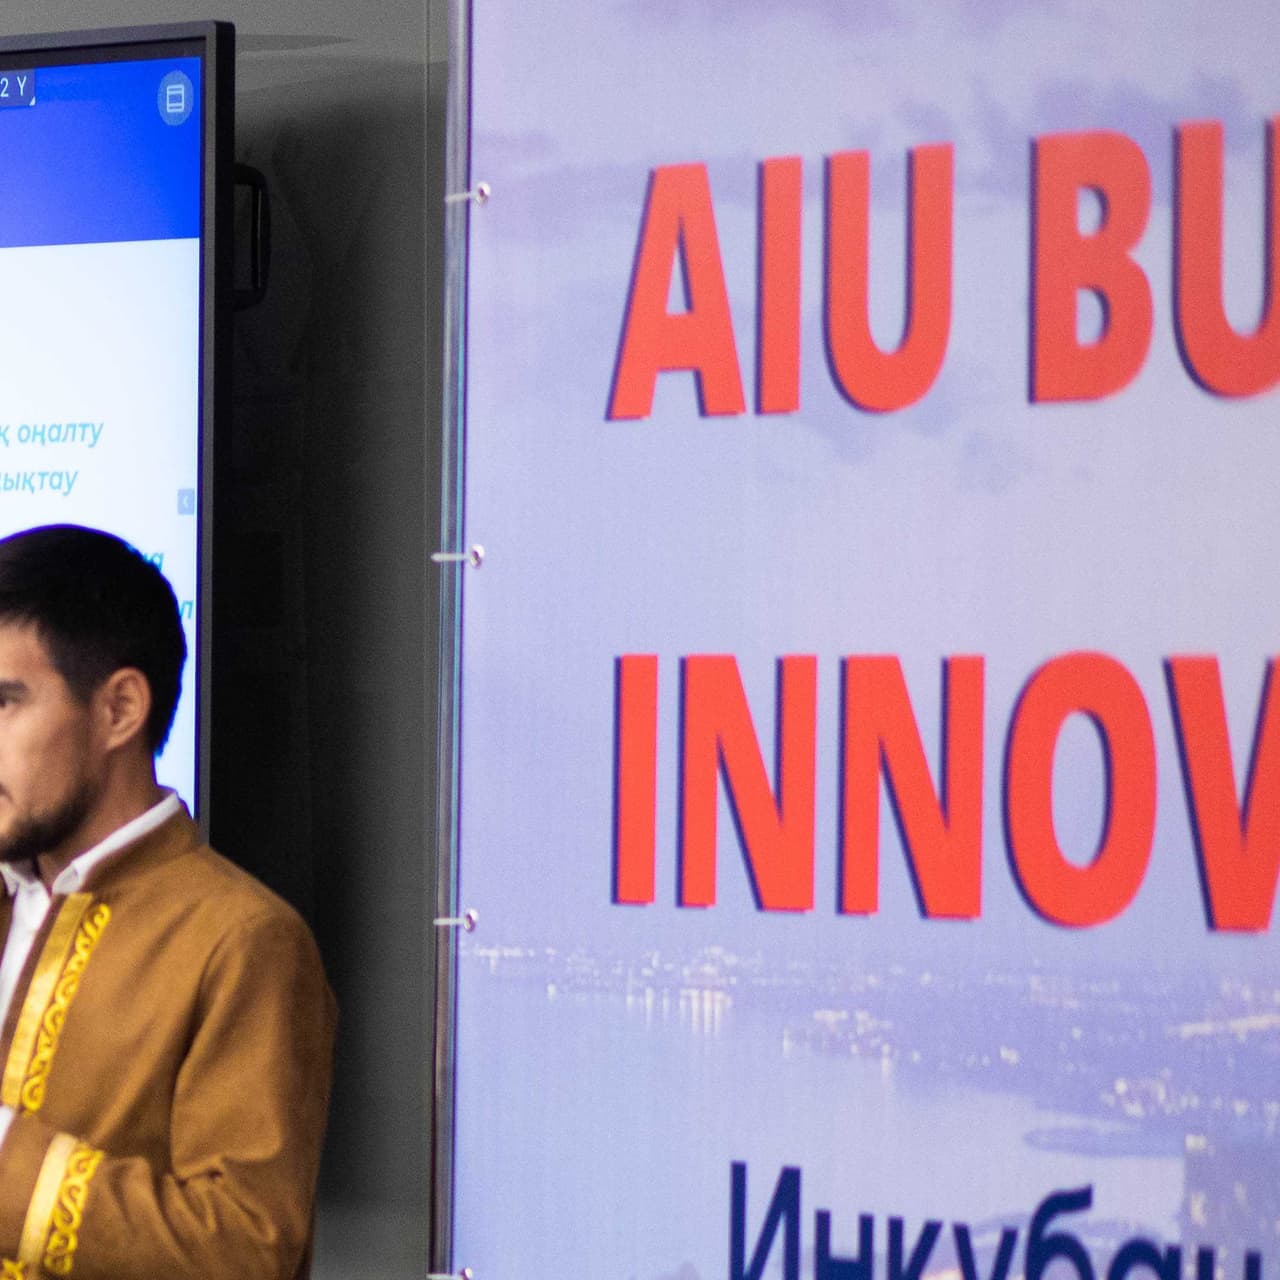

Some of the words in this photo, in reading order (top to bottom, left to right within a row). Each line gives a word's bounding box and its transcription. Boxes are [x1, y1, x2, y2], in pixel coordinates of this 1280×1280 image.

[605, 143, 954, 422] AIU
[17, 421, 104, 449] оңалту
[610, 650, 1280, 934] INNOV
